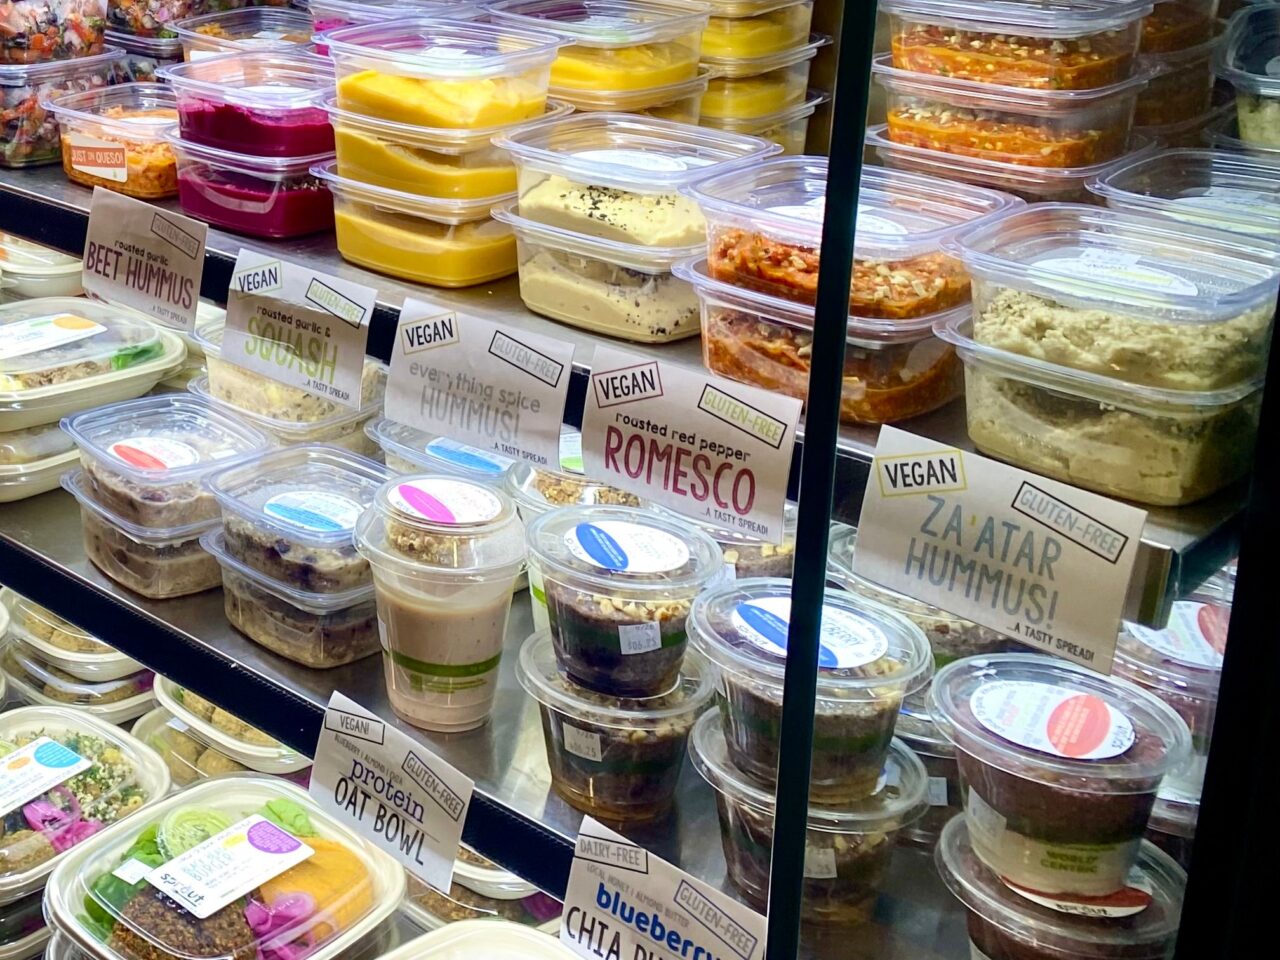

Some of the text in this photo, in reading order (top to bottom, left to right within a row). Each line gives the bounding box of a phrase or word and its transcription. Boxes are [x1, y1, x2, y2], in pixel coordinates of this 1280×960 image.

[72, 150, 86, 162] JUST
[114, 240, 169, 266] roasted garlic
[86, 241, 194, 310] BEET HUMMUS
[239, 267, 278, 293] VEGAN
[156, 306, 170, 318] TASTY
[256, 305, 331, 338] roasted garlic &
[309, 283, 360, 321] GLUTEN-FREE
[244, 316, 339, 385] SQUASH
[405, 318, 454, 348] VEGAN
[493, 337, 558, 381] GLUTEN-FREE
[312, 381, 328, 393] TASTY
[409, 361, 541, 413] everything spice
[598, 369, 656, 401] VEGAN
[420, 386, 520, 443] HUMMUS!
[703, 390, 781, 442] GLUTEN-FREE
[501, 443, 548, 465] TASTY SPREAD!
[615, 412, 751, 462] roasted red pepper
[604, 425, 756, 516] ROMESCO
[884, 457, 958, 489] VEGAN
[713, 509, 769, 535] TASTY SPREAD!
[1019, 489, 1121, 556] GLUTEN-FREE
[904, 536, 1059, 630] HUMMUS!
[1024, 626, 1095, 663] TASTY SPREAD!
[339, 715, 370, 735] VEGAN!
[348, 758, 425, 825] protein
[406, 757, 461, 816] GLUTEN-FREE
[334, 777, 425, 866] OAT BOWL
[579, 840, 641, 866] DAIRY-FREE
[566, 906, 620, 960] CHIA
[679, 887, 755, 955] GLUTEN-FREE
